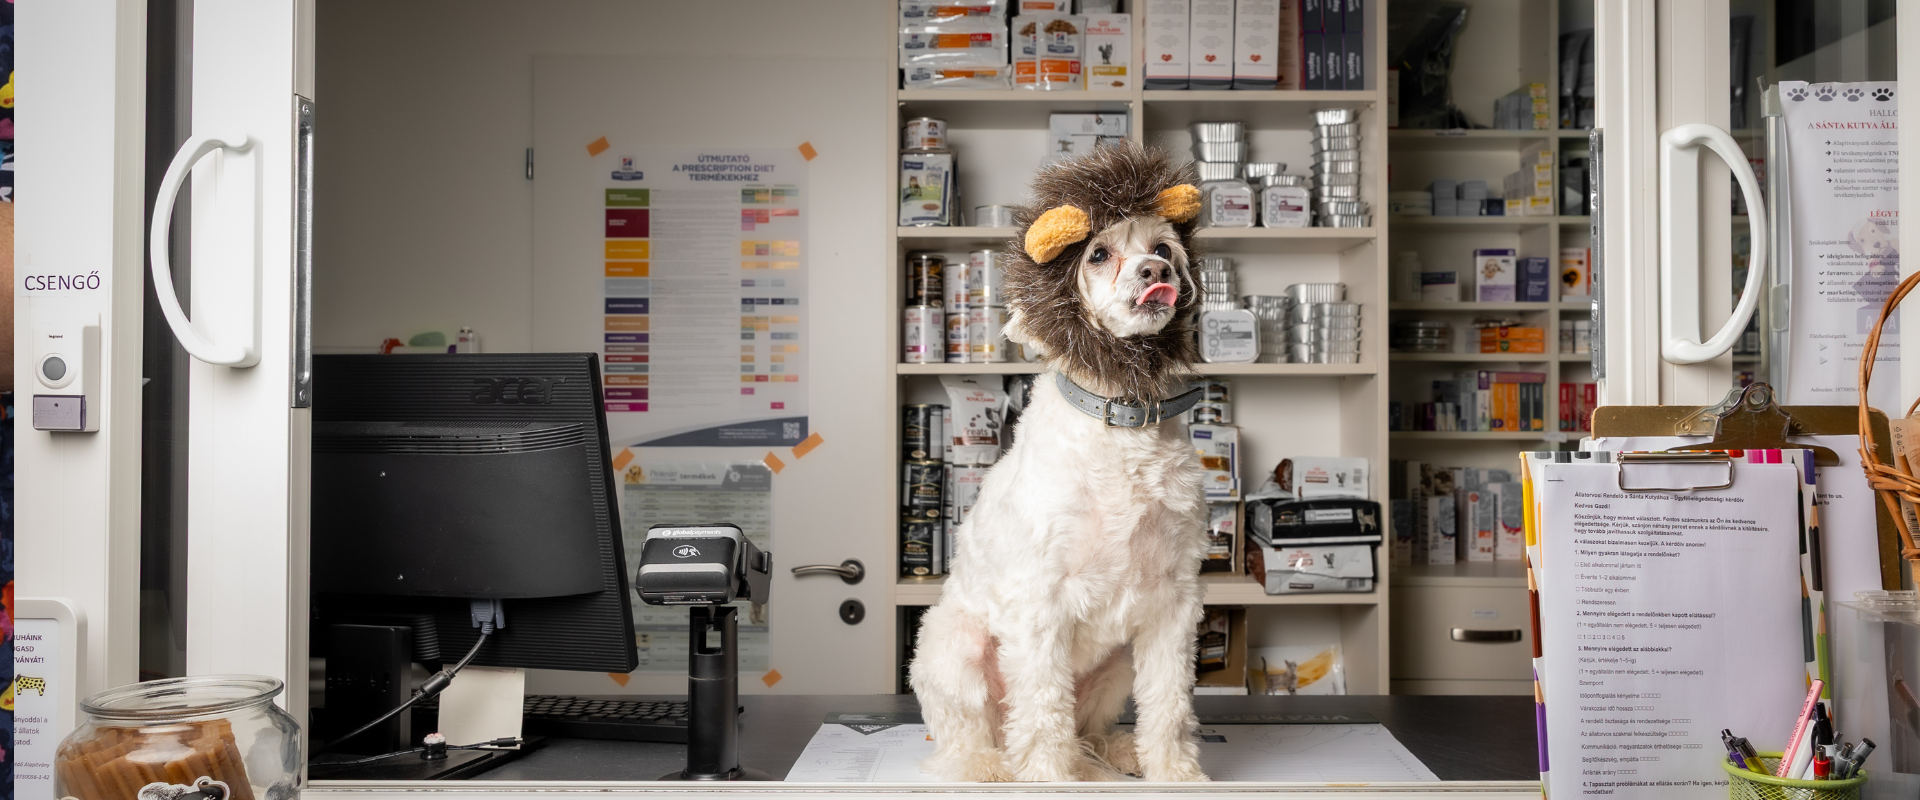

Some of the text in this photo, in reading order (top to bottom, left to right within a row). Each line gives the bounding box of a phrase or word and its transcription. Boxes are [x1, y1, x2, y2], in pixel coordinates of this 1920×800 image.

[1816, 120, 1845, 129] SÁNTA
[698, 154, 750, 163] ÚTMUTATÓ
[689, 172, 759, 181] TERMÉKEKHEZ
[1215, 194, 1224, 222] SOLO
[1269, 194, 1278, 224] SOLO
[25, 271, 100, 290] CSENGŐ
[1208, 318, 1220, 358] SOLO
[470, 377, 565, 404] acer
